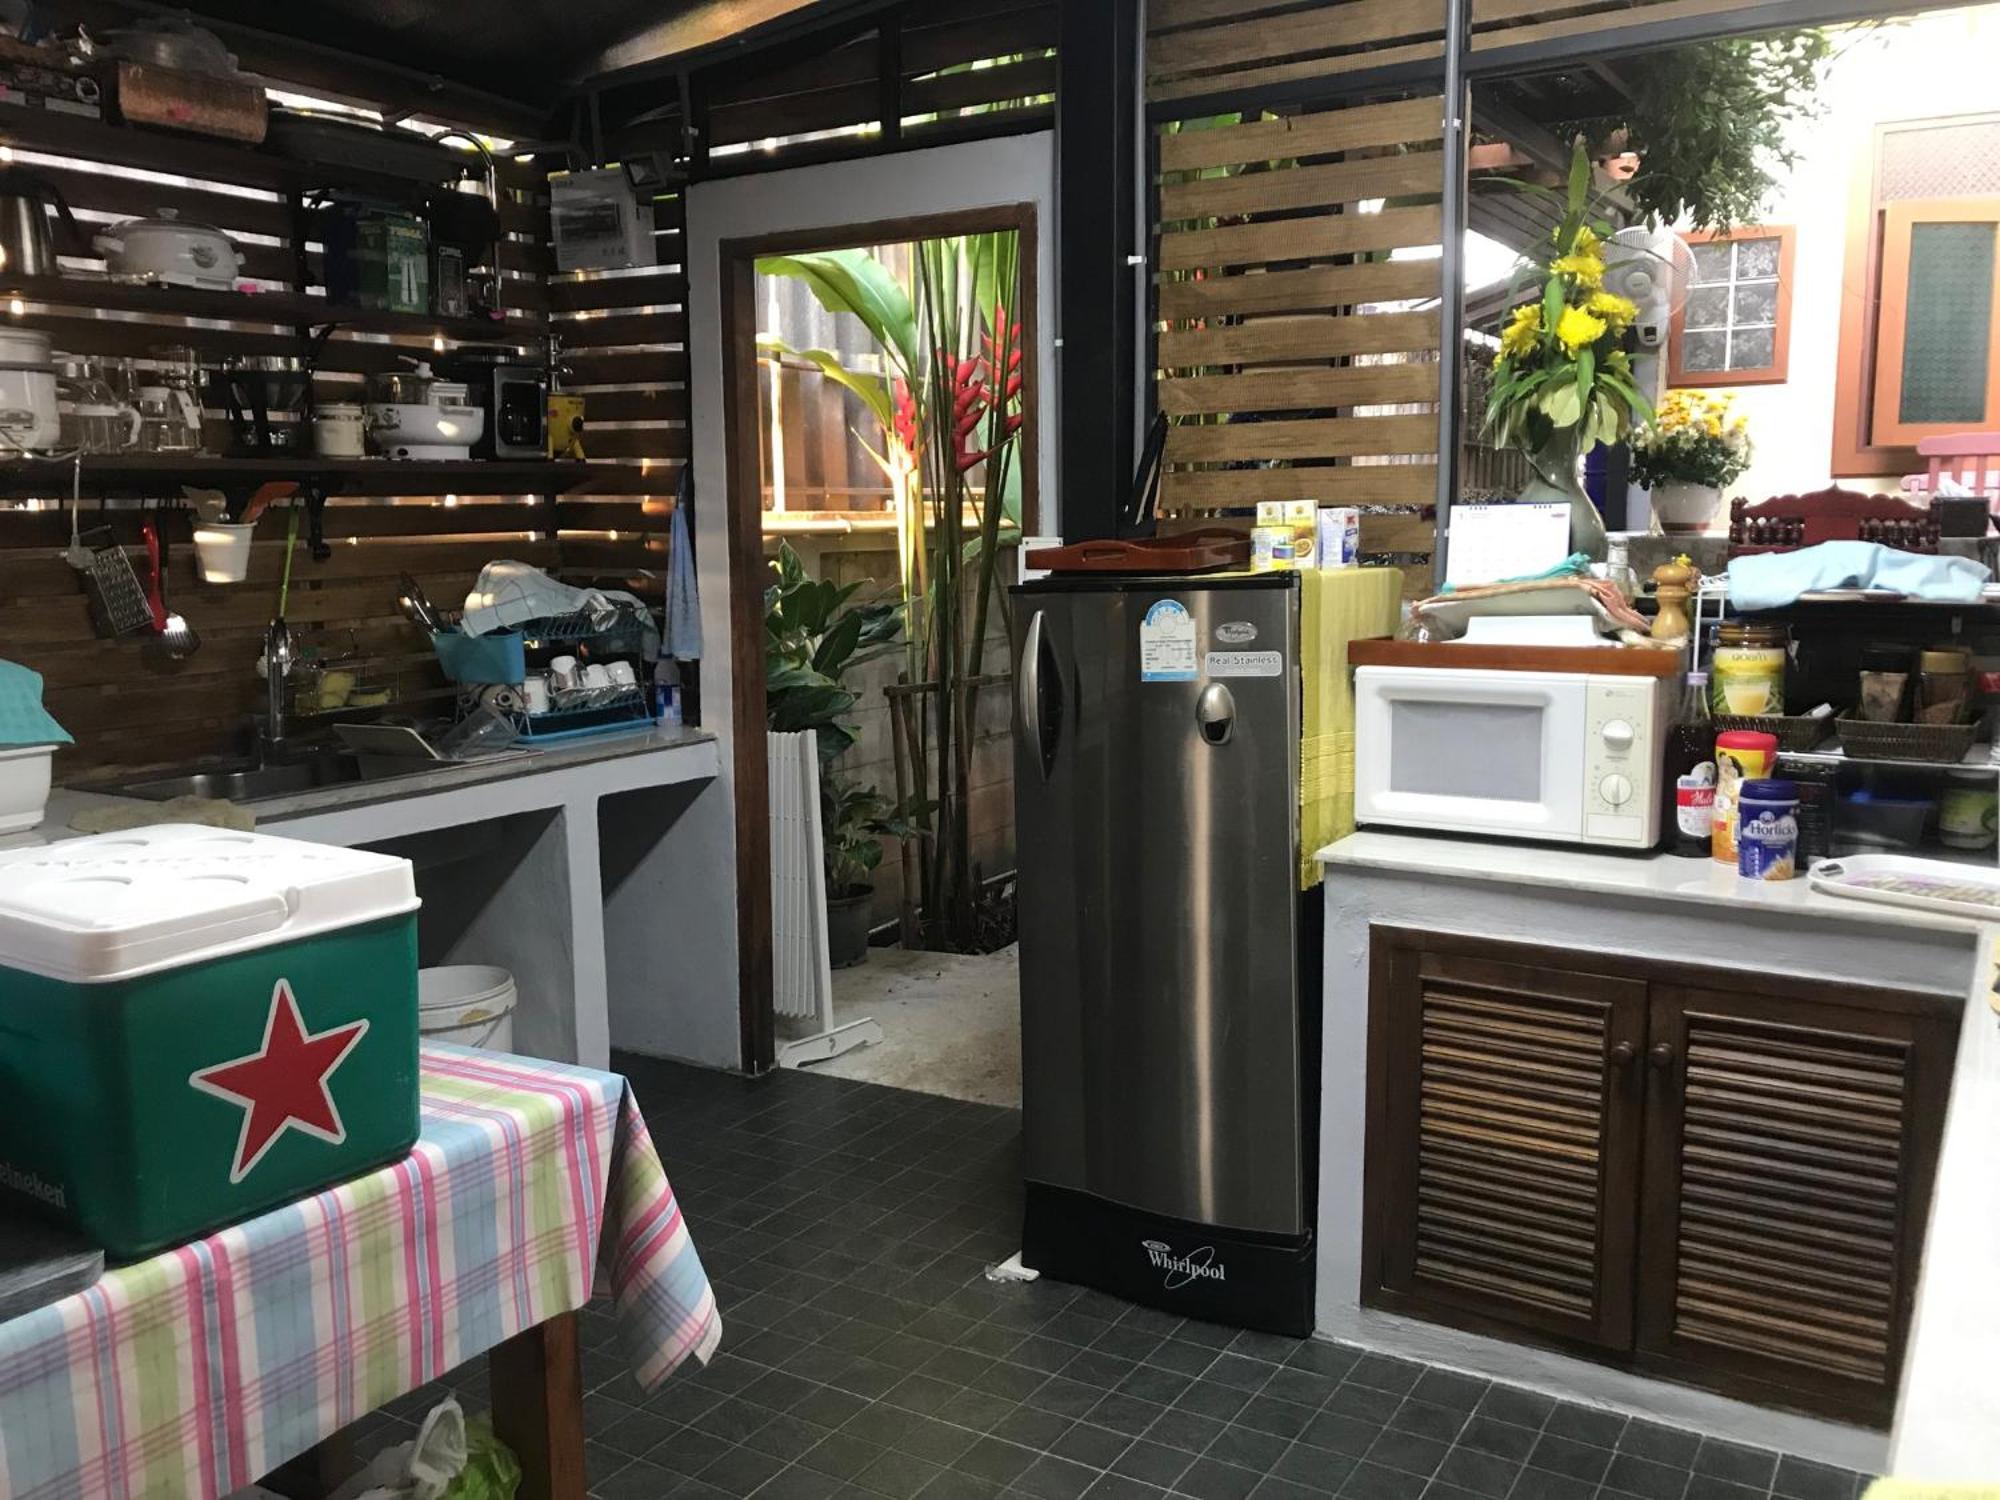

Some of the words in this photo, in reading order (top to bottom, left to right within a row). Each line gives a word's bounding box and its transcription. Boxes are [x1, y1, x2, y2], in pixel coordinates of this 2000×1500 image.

[1209, 656, 1230, 665] Real
[1234, 656, 1278, 665] Stainless
[1147, 1248, 1226, 1281] Whirlpool
